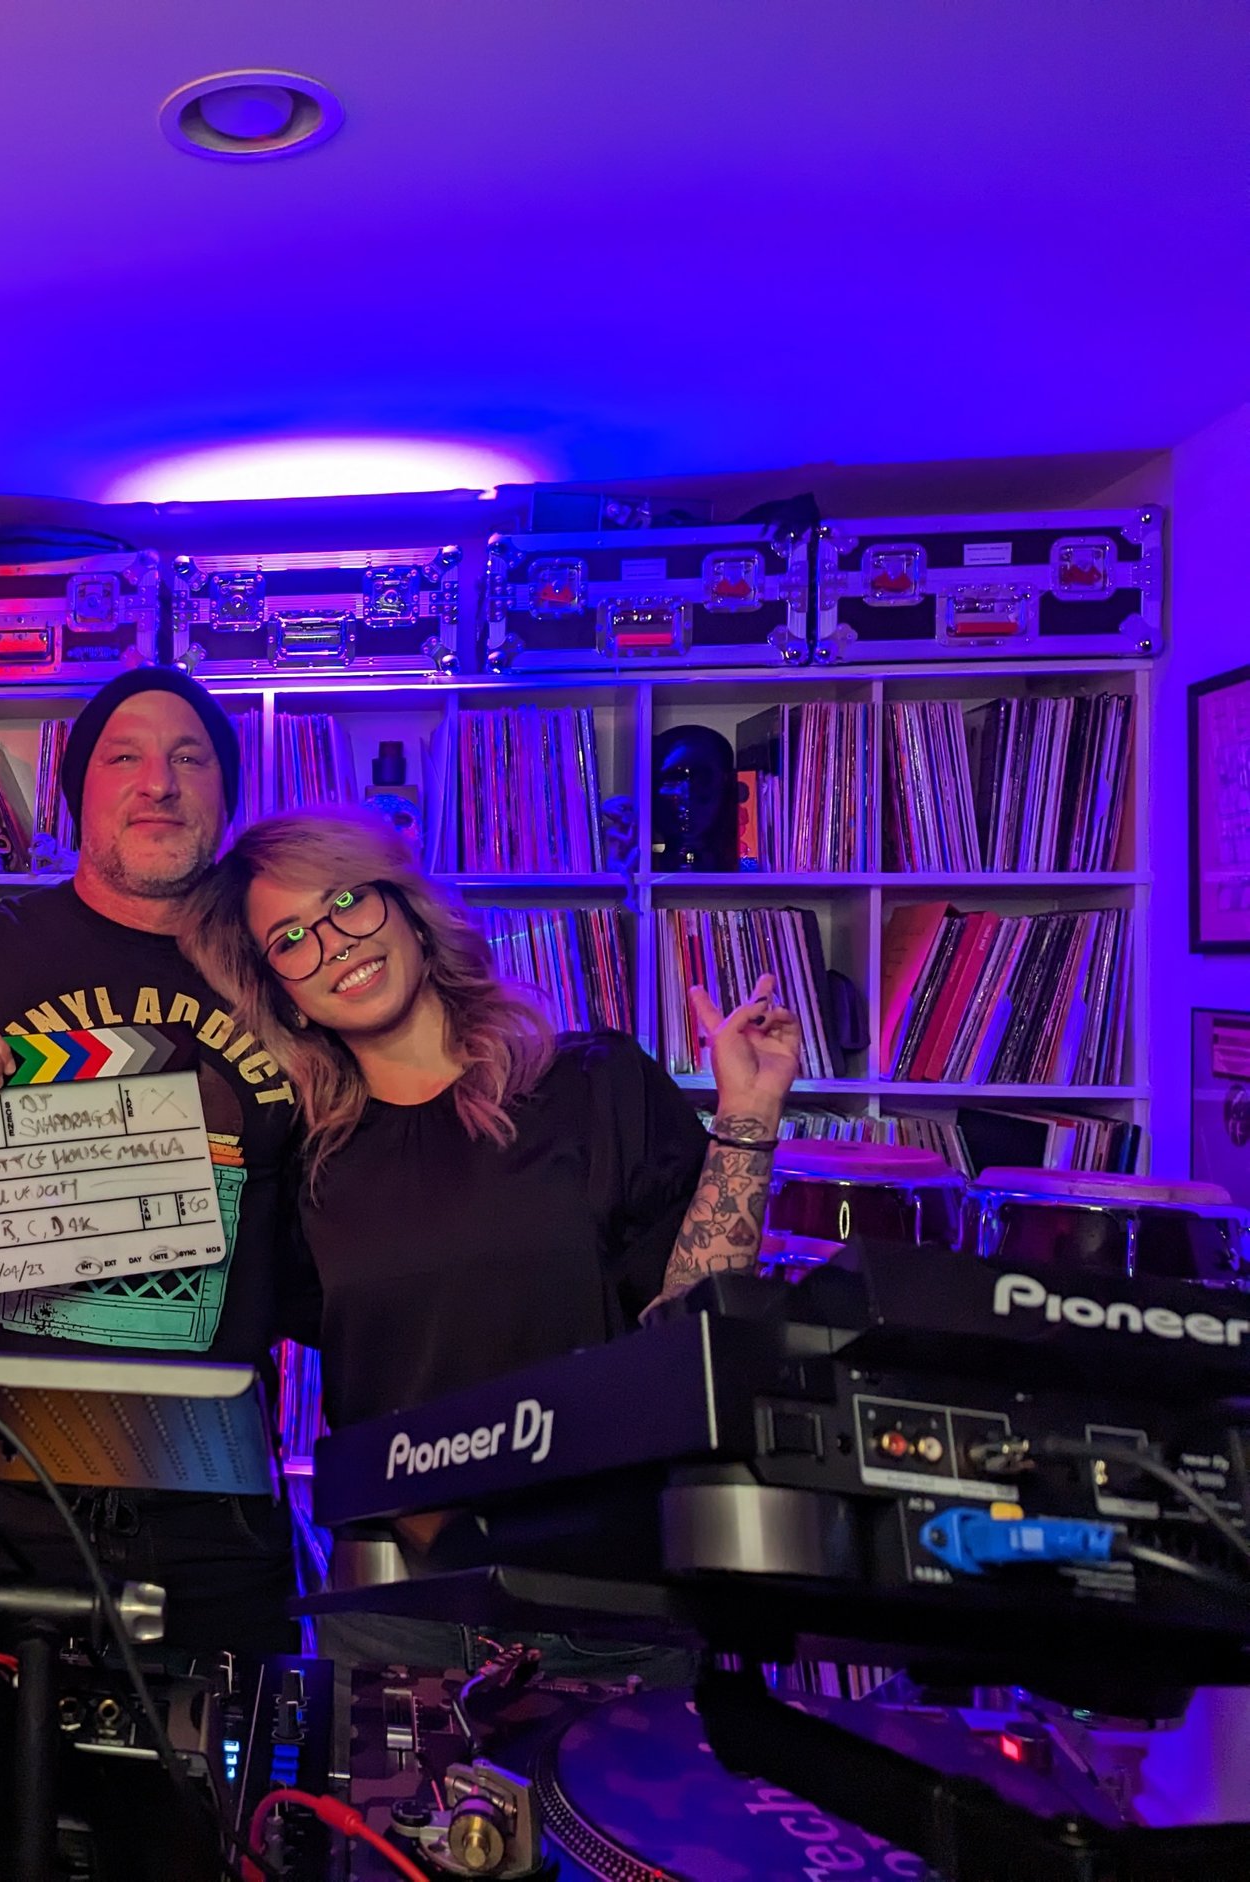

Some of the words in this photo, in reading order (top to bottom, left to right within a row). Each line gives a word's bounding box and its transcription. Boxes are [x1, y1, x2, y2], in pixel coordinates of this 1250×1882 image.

[5, 986, 123, 1036] NYL
[133, 986, 296, 1106] ADDICT
[124, 1090, 134, 1117] TAKE
[5, 1102, 15, 1136] SCENE
[52, 1144, 111, 1170] HOUSE
[142, 1199, 151, 1221] CAM
[178, 1194, 186, 1216] FPS
[188, 1196, 209, 1212] 60
[81, 1261, 92, 1270] INT
[104, 1259, 117, 1267] EXT
[128, 1256, 142, 1264] DAY
[178, 1249, 197, 1257] SYNC
[993, 1273, 1250, 1346] Pioneer
[386, 1422, 506, 1480] Pioneer
[512, 1399, 554, 1463] DJ
